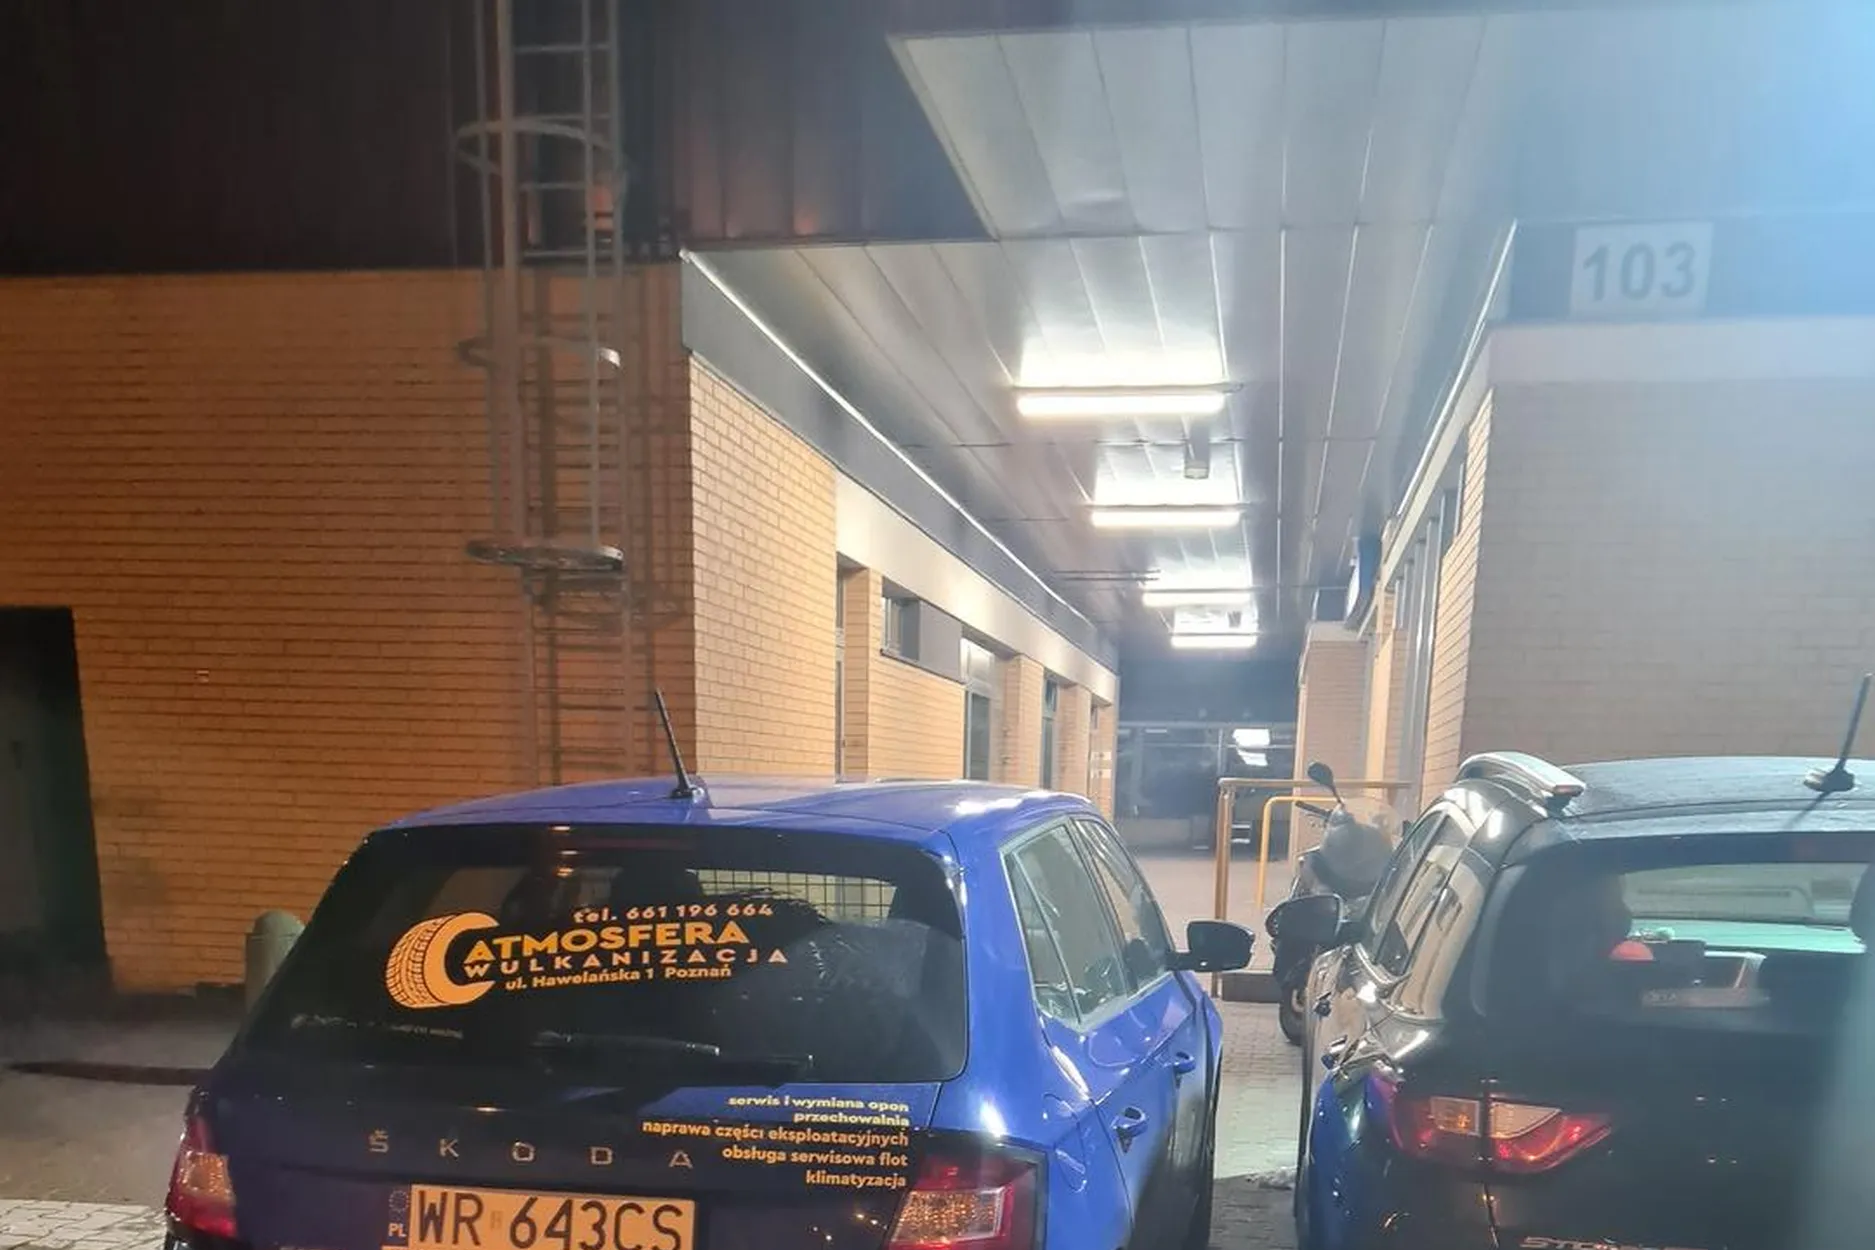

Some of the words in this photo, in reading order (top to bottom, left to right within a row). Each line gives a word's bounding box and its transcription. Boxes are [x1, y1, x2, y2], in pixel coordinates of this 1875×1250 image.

[1583, 240, 1696, 301] 103
[573, 907, 618, 924] tel.
[626, 905, 668, 921] 661
[676, 903, 719, 918] 196
[726, 903, 774, 918] 664
[463, 920, 750, 964] ATMOSFERA
[463, 948, 789, 978] WULKANIZACJA
[505, 976, 528, 991] ul.
[646, 967, 654, 980] 1
[664, 965, 732, 979] Poznań
[728, 1095, 781, 1107] serwis
[791, 1098, 865, 1113] wymiana
[868, 1101, 909, 1114] opon
[793, 1112, 910, 1128] przechowalnia
[643, 1120, 711, 1137] naprawa
[714, 1122, 765, 1140] części
[768, 1124, 909, 1148] eksploatacyjnych
[368, 1130, 693, 1169] ŠKODA
[722, 1146, 787, 1164] obsługa
[791, 1151, 876, 1167] serwisowa
[880, 1152, 908, 1168] flot
[806, 1169, 907, 1190] klimatyzacja
[388, 1222, 407, 1238] PL
[418, 1190, 484, 1247] WR
